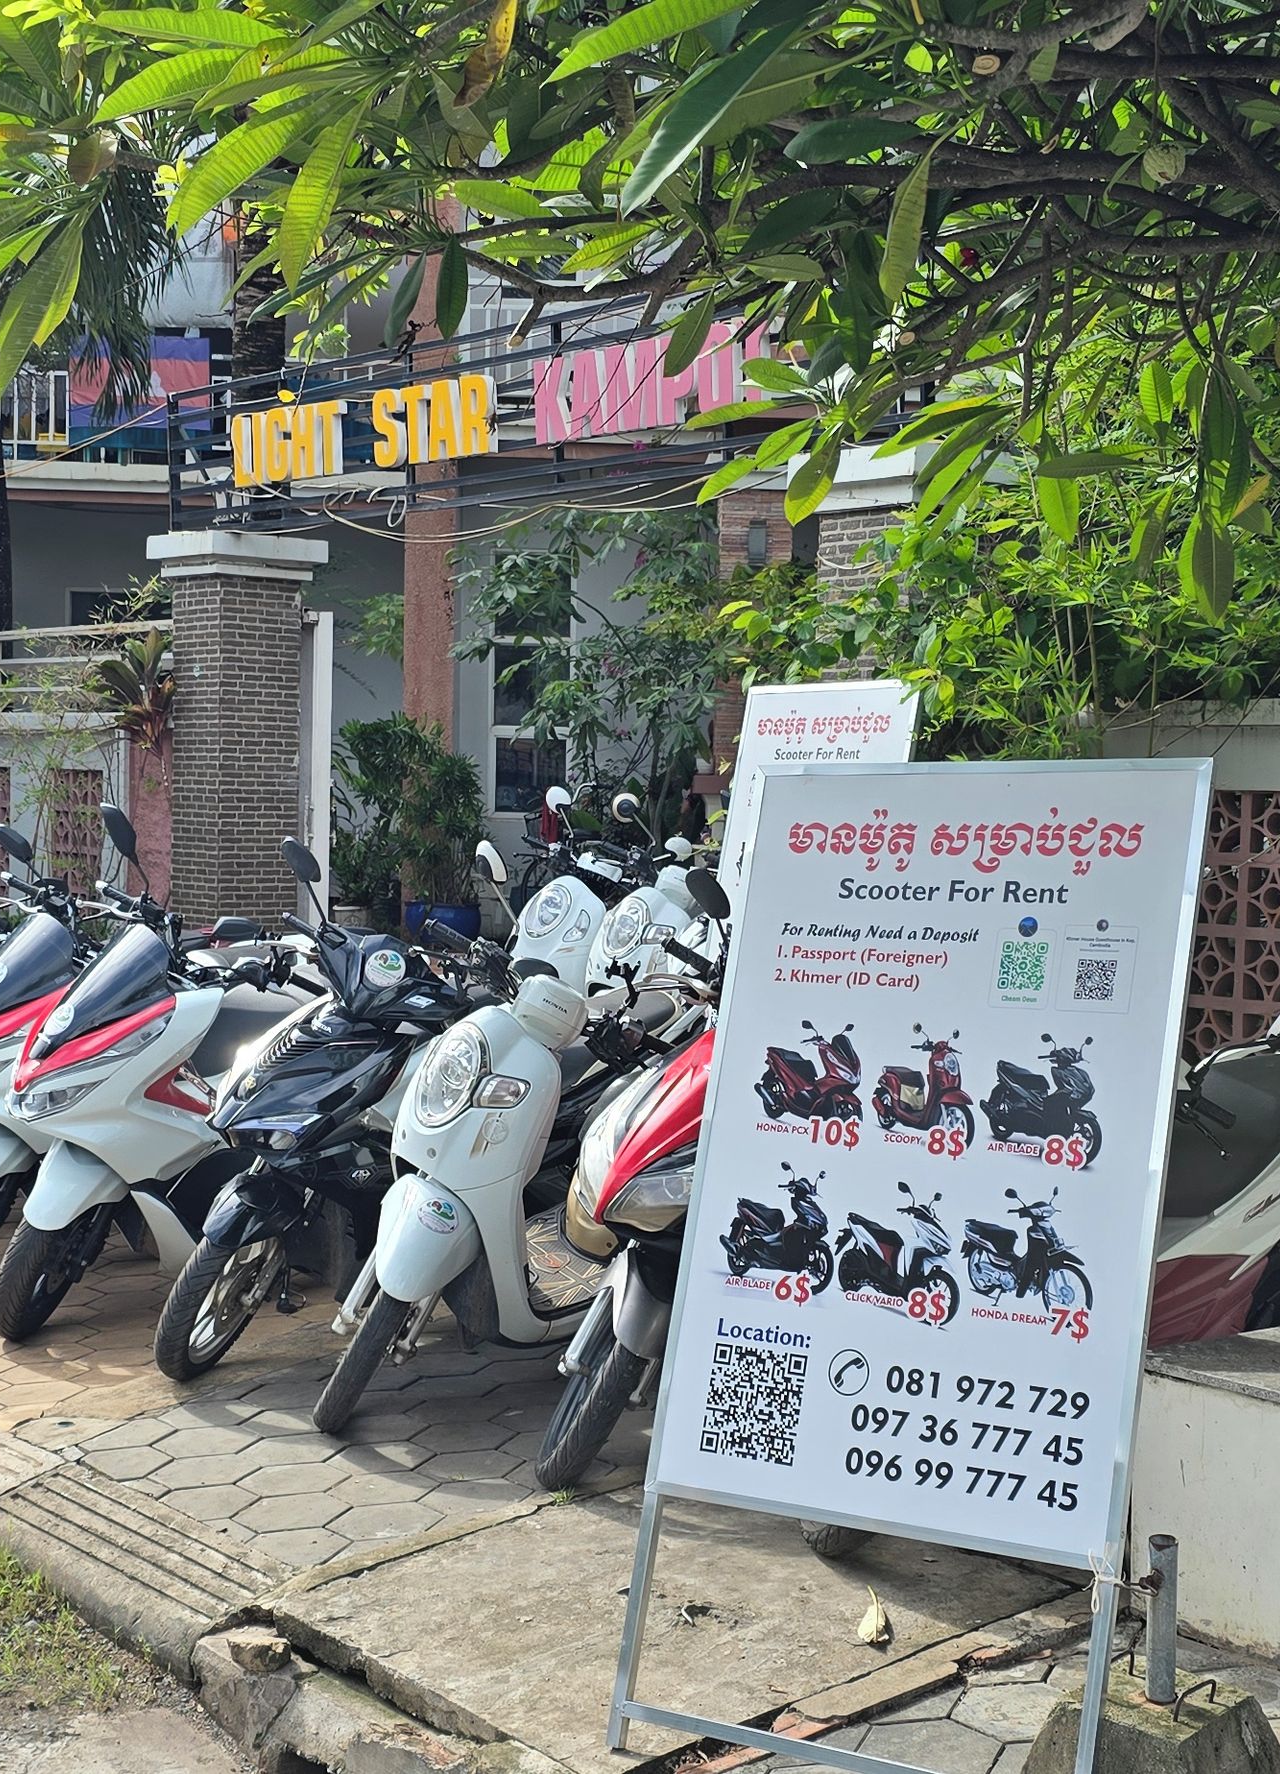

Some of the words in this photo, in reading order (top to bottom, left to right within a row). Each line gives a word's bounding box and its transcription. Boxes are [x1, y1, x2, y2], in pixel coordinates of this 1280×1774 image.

[232, 400, 347, 488] LIGHT
[372, 374, 499, 469] STAR
[774, 747, 813, 761] Scooter
[816, 747, 834, 760] For
[836, 747, 860, 760] Rent
[788, 808, 919, 873] មានម៉ូតូ
[930, 806, 1145, 876] សម្រាប់ជួល
[838, 877, 940, 902] Scooter
[947, 879, 995, 903] For
[1003, 880, 1069, 905] Rent
[781, 922, 804, 936] For
[806, 923, 861, 941] Renting
[865, 925, 904, 940] Need
[907, 930, 917, 940] a
[921, 926, 980, 944] Deposit
[777, 944, 788, 958] 1.
[791, 945, 857, 964] Passport
[860, 947, 948, 969] (Foreigner)
[774, 968, 787, 982] 2.
[790, 968, 843, 985] Khmer
[846, 971, 870, 989] (ID
[875, 972, 920, 992] Card)
[543, 998, 568, 1014] HONDA
[756, 1122, 790, 1134] HONDA
[791, 1125, 810, 1136] PCX
[810, 1118, 860, 1151] 10$
[883, 1133, 922, 1145] SCOOPY
[927, 1126, 966, 1161] 8$
[987, 1142, 1004, 1153] AIR
[1006, 1143, 1040, 1155] BLADE
[1044, 1136, 1085, 1171] 8$
[725, 1276, 741, 1287] AIR
[742, 1277, 771, 1290] BLADE
[775, 1273, 810, 1307] 6$
[845, 1291, 904, 1307] CLICK/VARIO
[907, 1290, 946, 1325] 8$
[717, 1317, 811, 1349] Location:
[971, 1307, 1009, 1320] HONDA
[1011, 1312, 1047, 1326] DREAM
[1050, 1307, 1090, 1344] 7$
[886, 1365, 940, 1399] 081
[956, 1375, 1015, 1410] 972
[1028, 1385, 1090, 1420] 729
[851, 1403, 910, 1437] 097
[918, 1414, 958, 1446] 36
[971, 1422, 1032, 1456] 777
[1042, 1434, 1084, 1466] 45
[845, 1447, 902, 1482] 096
[914, 1458, 953, 1489] 99
[965, 1466, 1027, 1501] 777
[1037, 1479, 1078, 1512] 45
